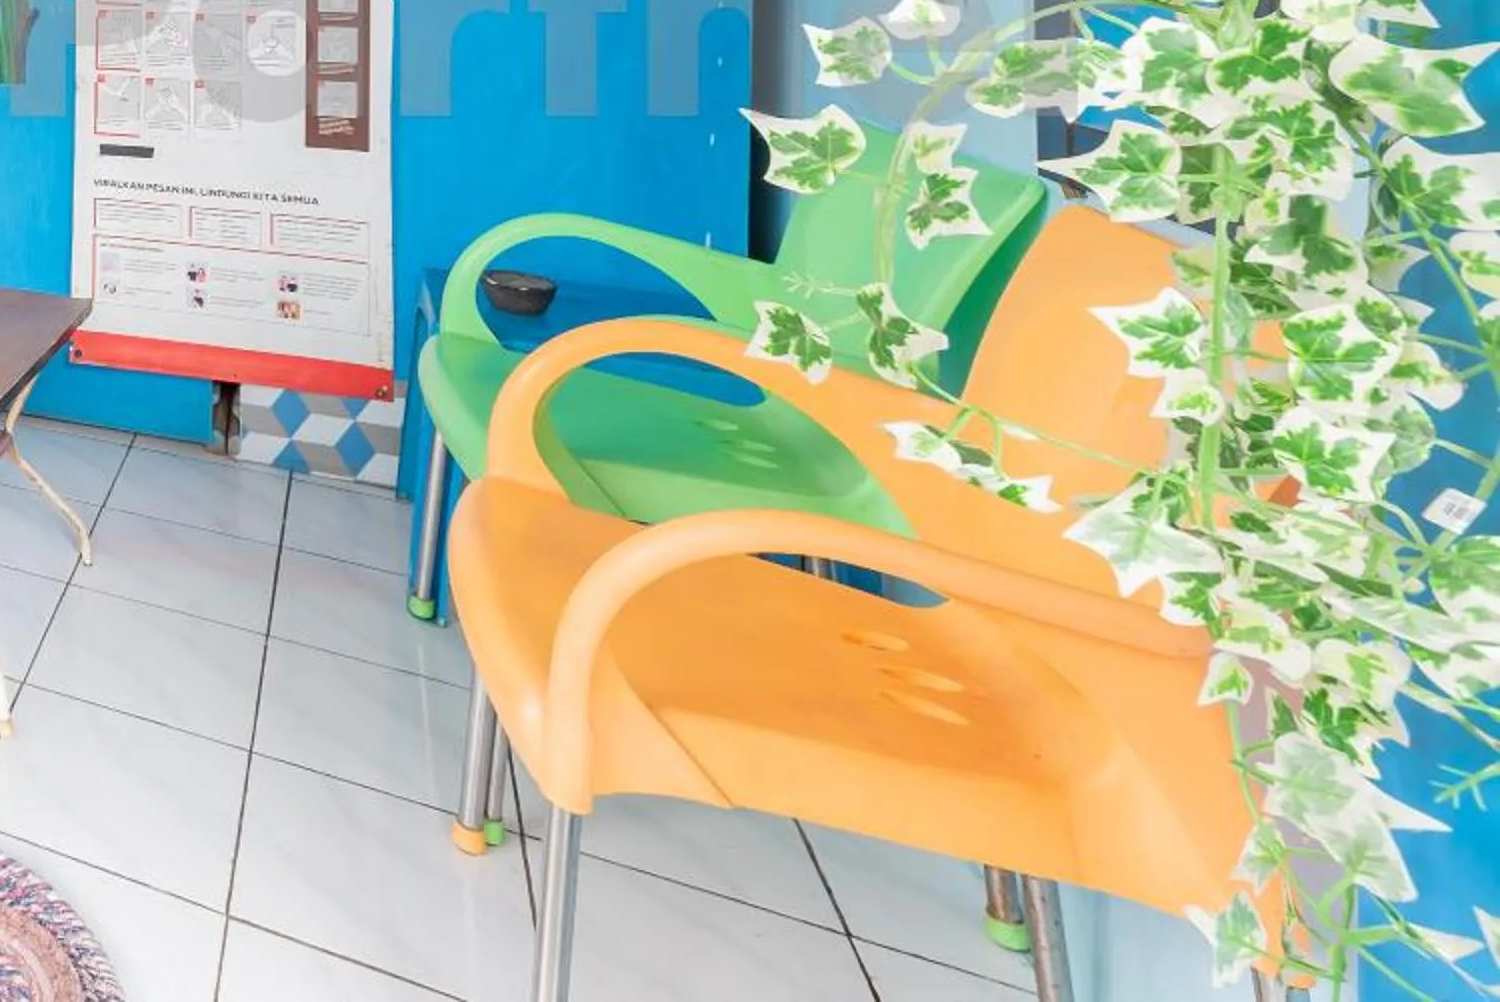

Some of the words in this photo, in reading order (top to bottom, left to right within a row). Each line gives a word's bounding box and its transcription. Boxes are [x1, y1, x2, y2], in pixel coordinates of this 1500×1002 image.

[93, 179, 144, 192] VIRALKAN
[146, 182, 180, 194] PESAN
[200, 189, 251, 200] LINDUNGI
[252, 192, 279, 203] KITA
[281, 194, 319, 206] SEMUA
